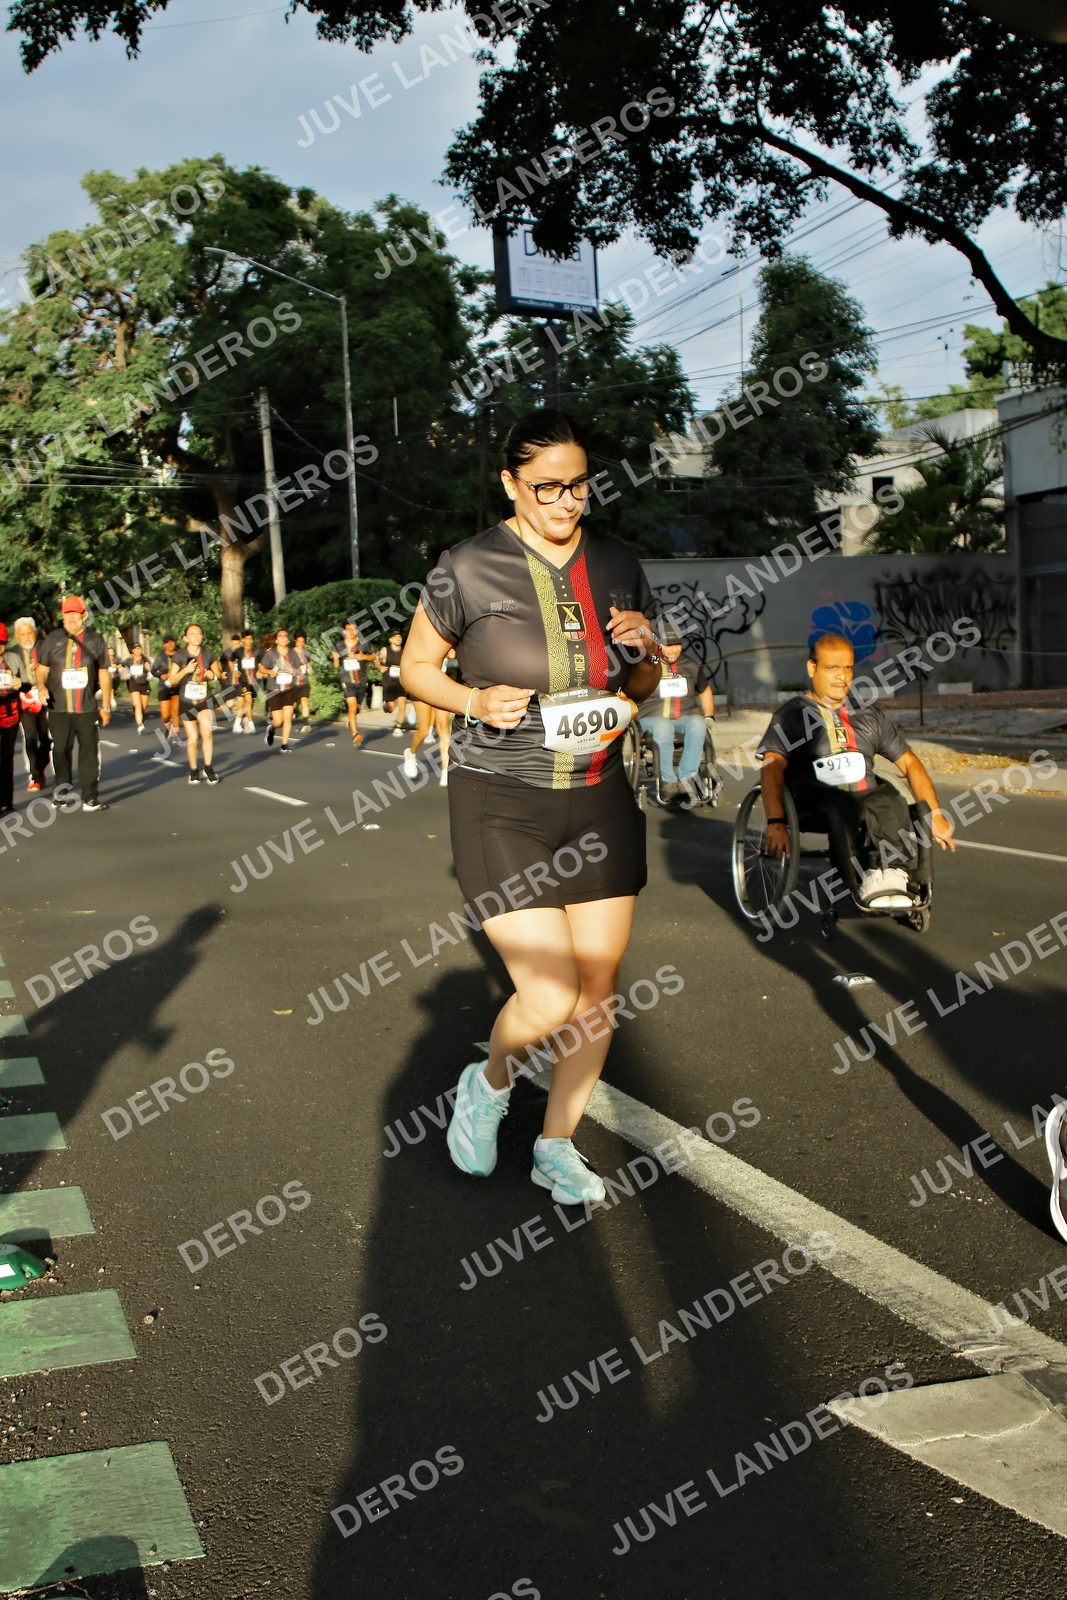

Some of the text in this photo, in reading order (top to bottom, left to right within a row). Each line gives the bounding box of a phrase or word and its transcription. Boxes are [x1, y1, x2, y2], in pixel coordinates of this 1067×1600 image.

[652, 580, 699, 599] TOY
[557, 707, 618, 739] 4690
[826, 756, 851, 771] 973
